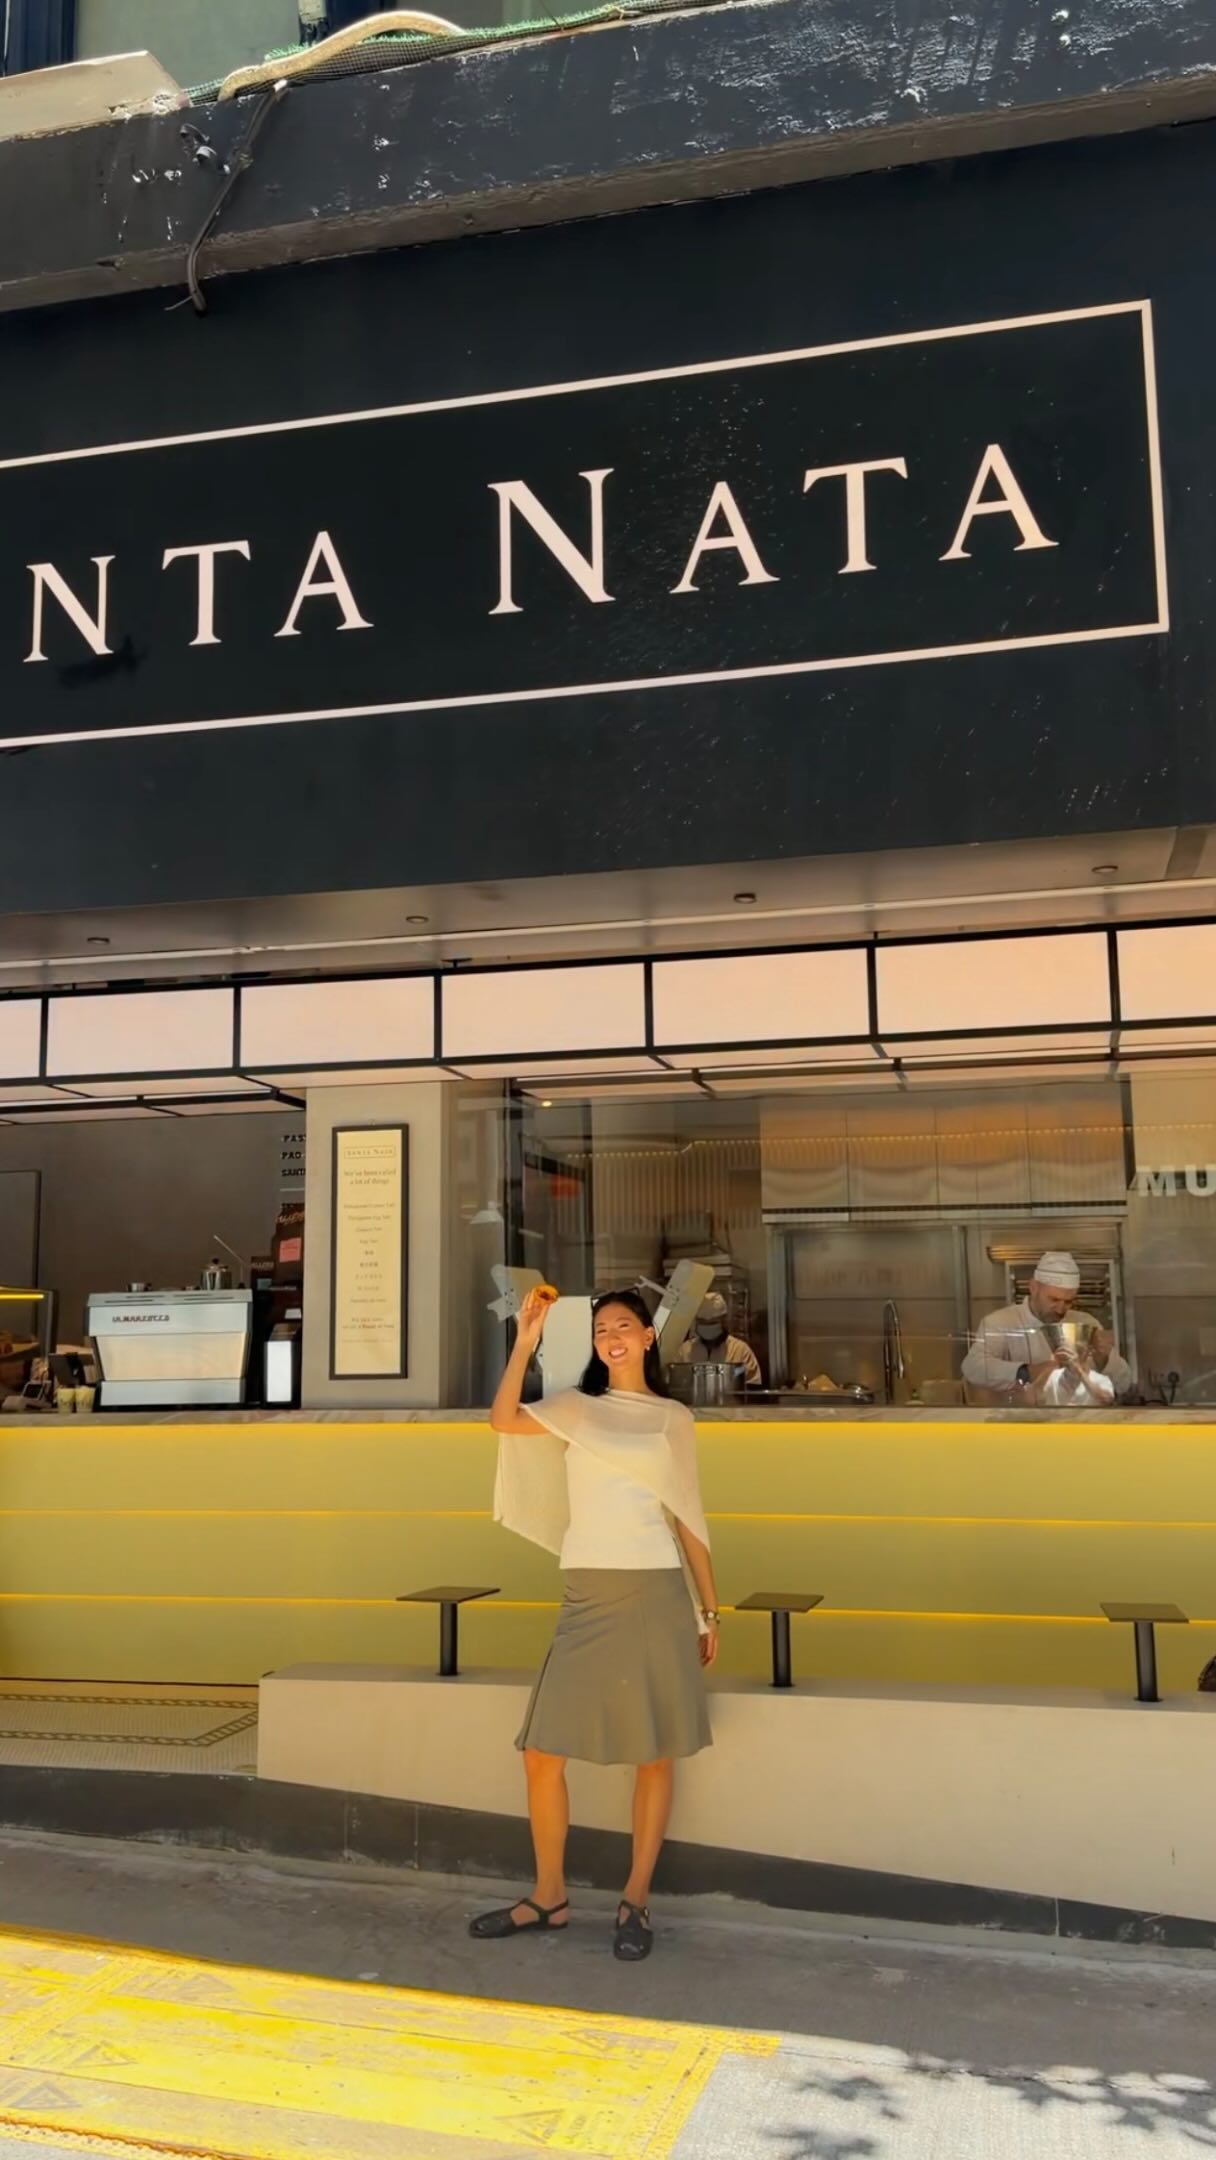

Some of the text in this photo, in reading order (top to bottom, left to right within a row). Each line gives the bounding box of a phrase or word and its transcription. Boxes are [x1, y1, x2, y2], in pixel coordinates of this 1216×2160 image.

[22, 444, 1060, 662] NTA NATA
[283, 1134, 306, 1142] PAS
